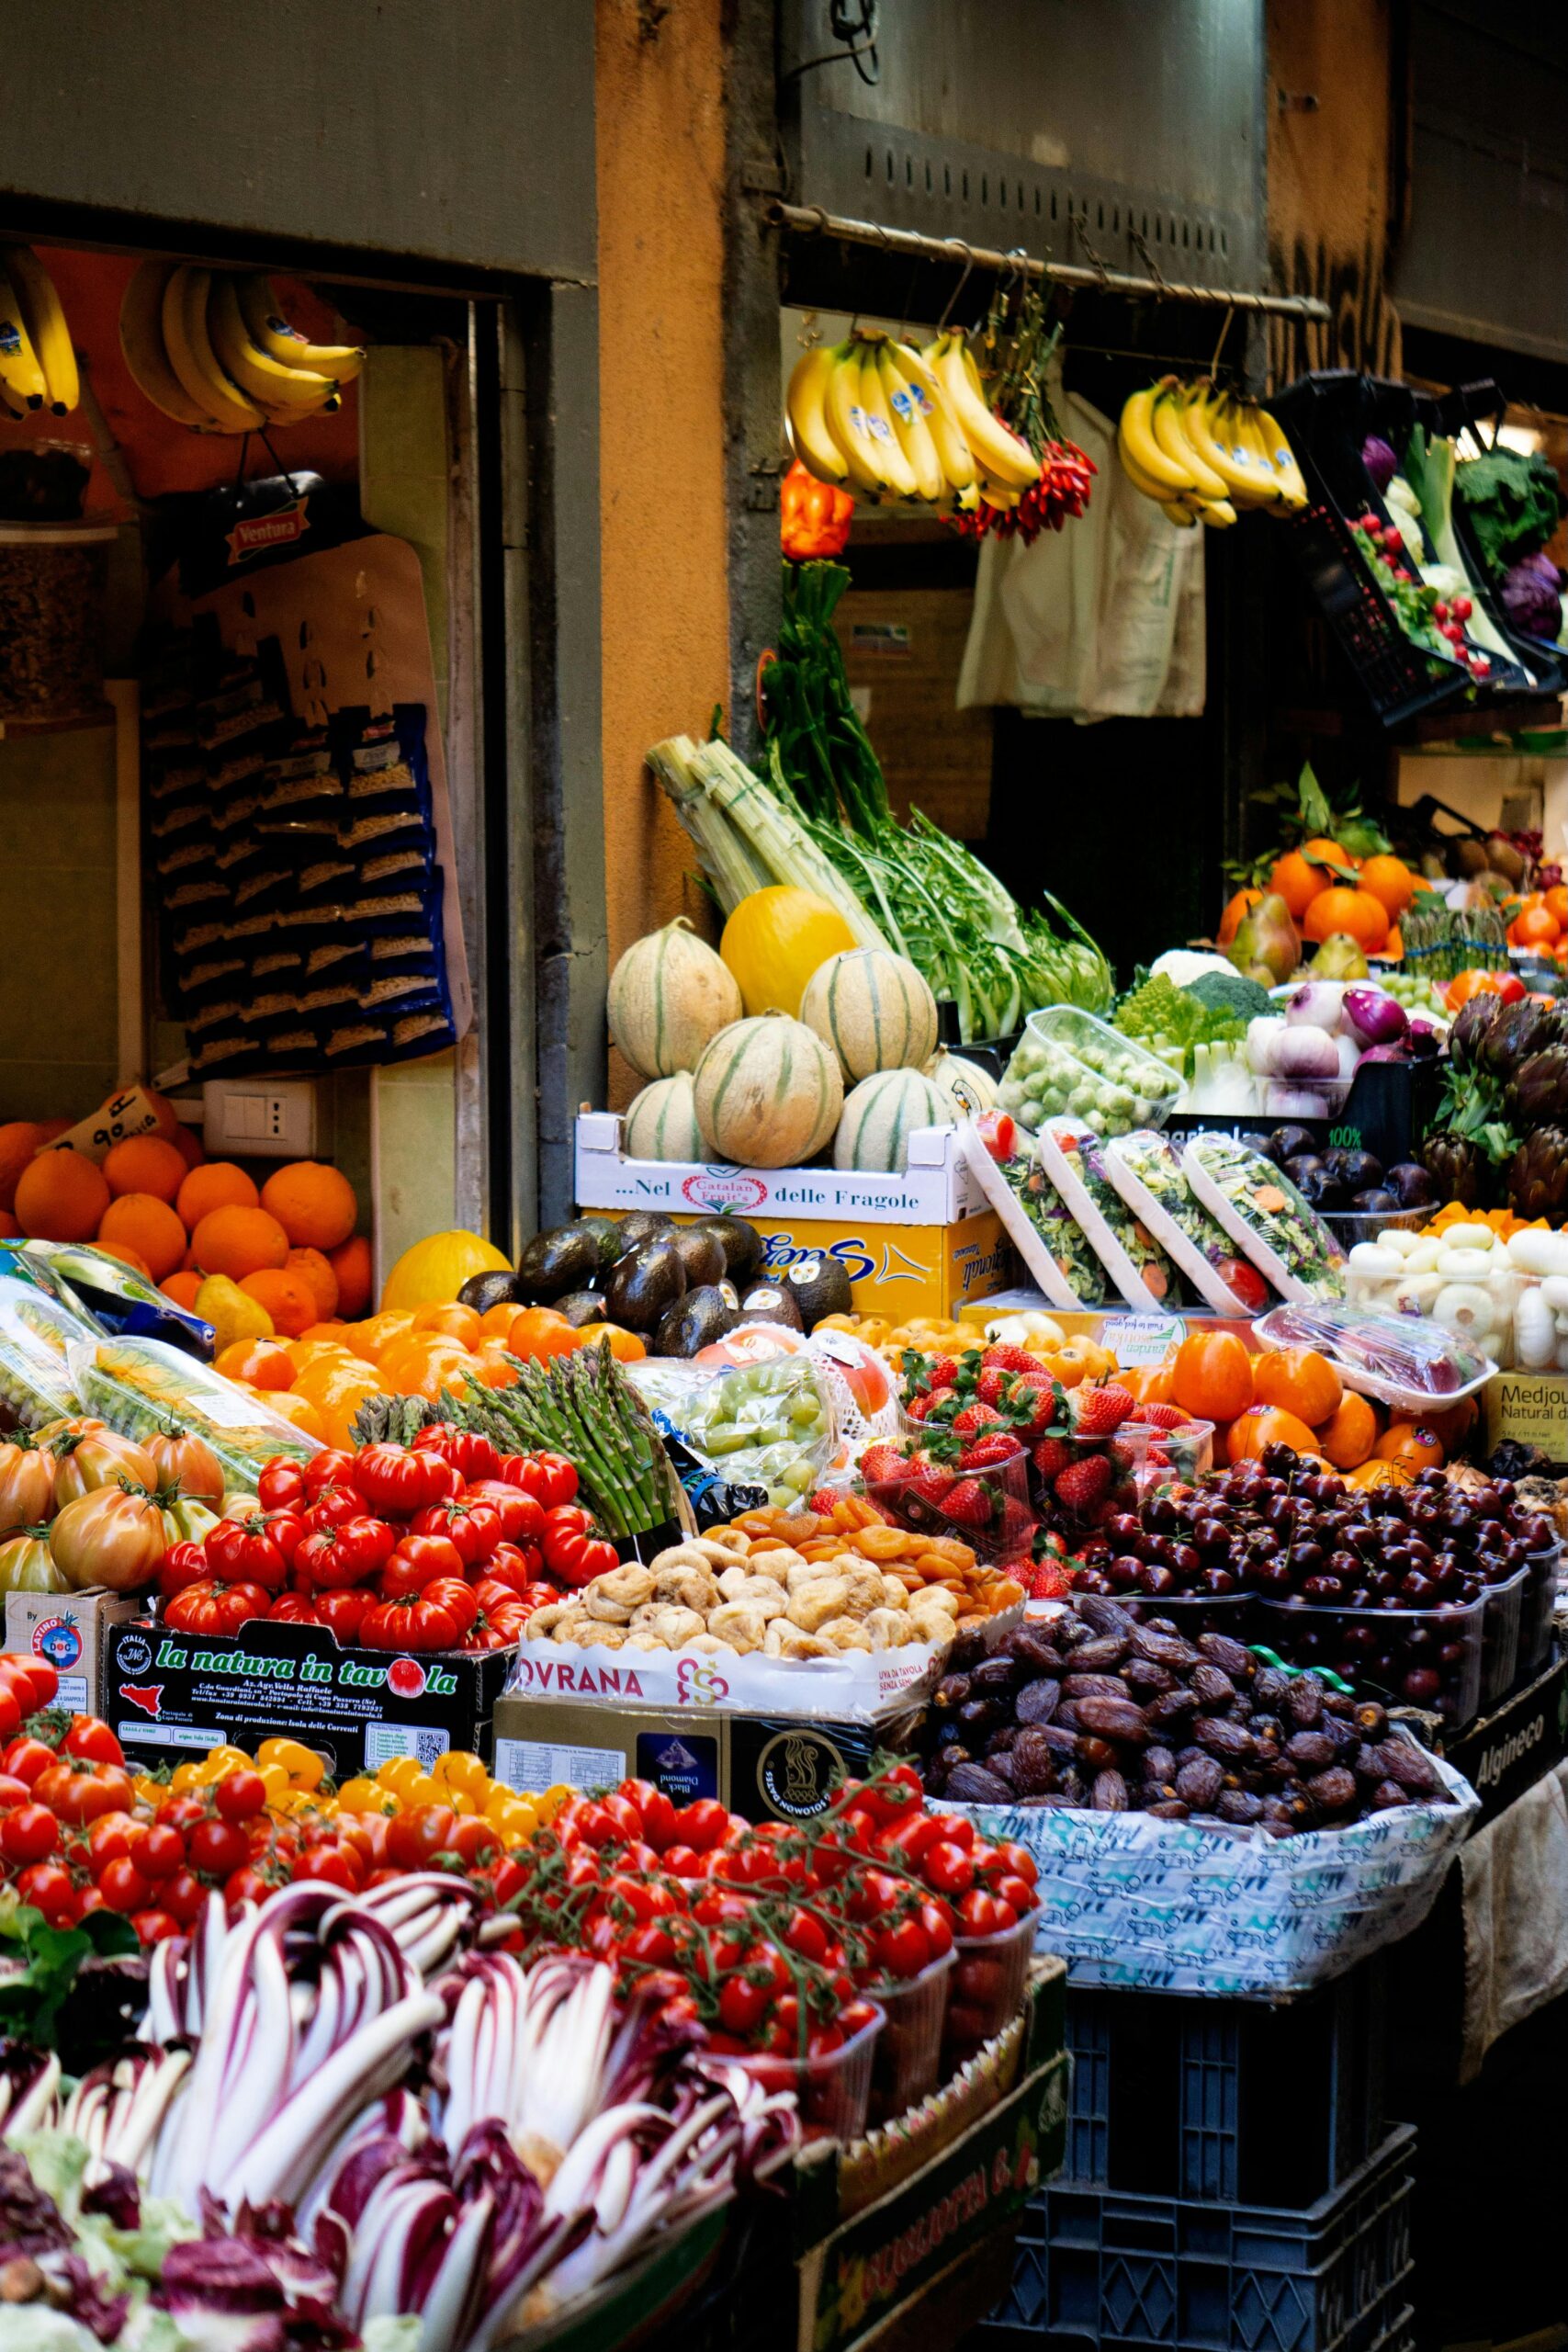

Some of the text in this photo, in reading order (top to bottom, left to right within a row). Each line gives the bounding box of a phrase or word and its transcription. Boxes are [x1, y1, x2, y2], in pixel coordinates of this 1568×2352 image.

[239, 521, 296, 543] Ventura
[1329, 1126, 1361, 1148] 100%
[696, 1180, 753, 1193] Catalan
[701, 1191, 749, 1203] Fruit's
[775, 1186, 826, 1204] delle
[835, 1190, 919, 1211] Fragole
[1501, 1405, 1553, 1419] Natural
[27, 1611, 38, 1622] By
[33, 1619, 58, 1653] LATINO
[121, 1634, 147, 1646] ITALIA
[156, 1640, 187, 1669] la
[191, 1651, 295, 1679] natura
[299, 1653, 333, 1683] in
[878, 1664, 923, 1680] UVA DA TAVOLA
[191, 1688, 218, 1697] Tel/fax
[274, 1681, 295, 1691] Vella
[297, 1683, 333, 1695] Raffaele
[879, 1679, 898, 1691] SENZA
[268, 1689, 304, 1700] Portopalo
[313, 1692, 332, 1702] Capo
[332, 1695, 361, 1705] Passero
[215, 1712, 359, 1734] Zona di produzione: Isola delle Correnti
[1475, 1713, 1544, 1790] Algineco
[660, 1773, 699, 1786] Diamond
[668, 1782, 691, 1794] Black
[764, 1770, 828, 1816] SOLOMON DATES
